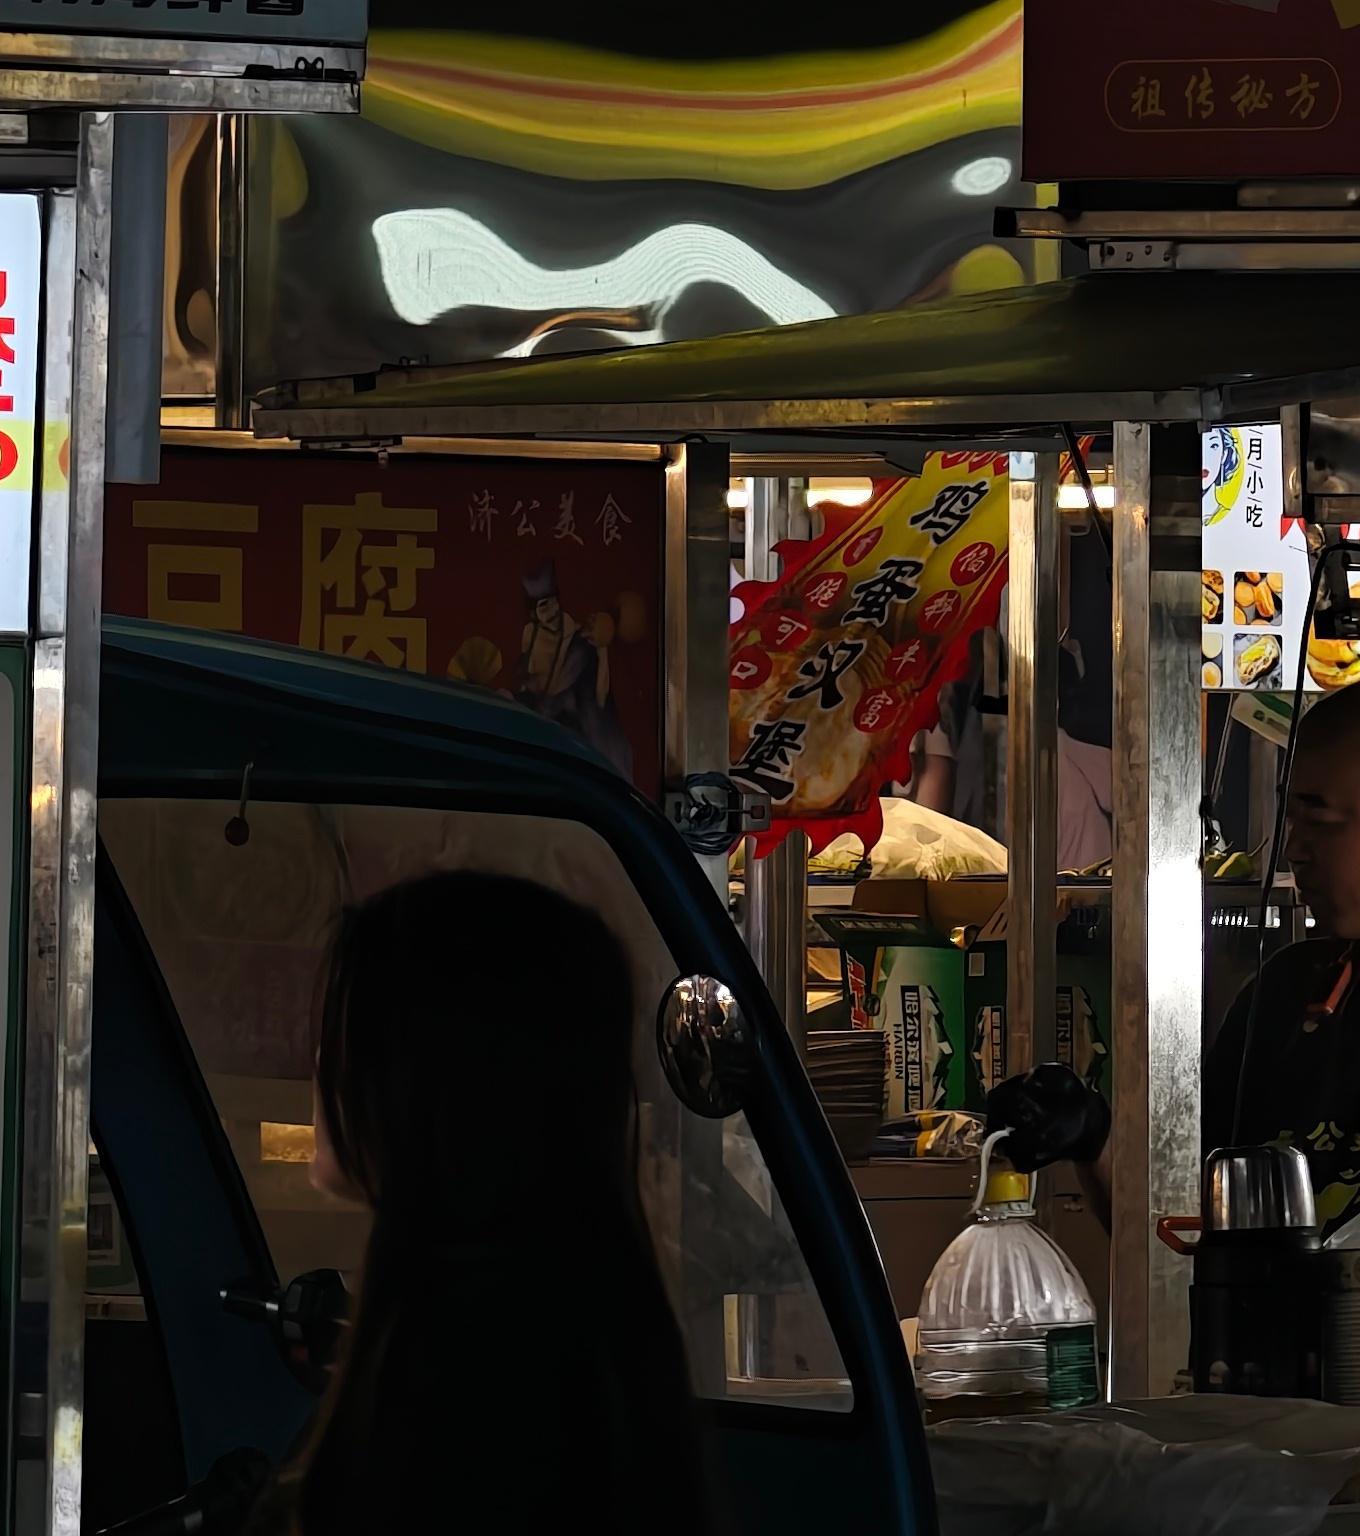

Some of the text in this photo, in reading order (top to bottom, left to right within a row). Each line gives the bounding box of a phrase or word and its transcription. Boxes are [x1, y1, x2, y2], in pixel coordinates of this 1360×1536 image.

[1130, 70, 1322, 122] 祖传秘方
[466, 488, 633, 547] 济公美食
